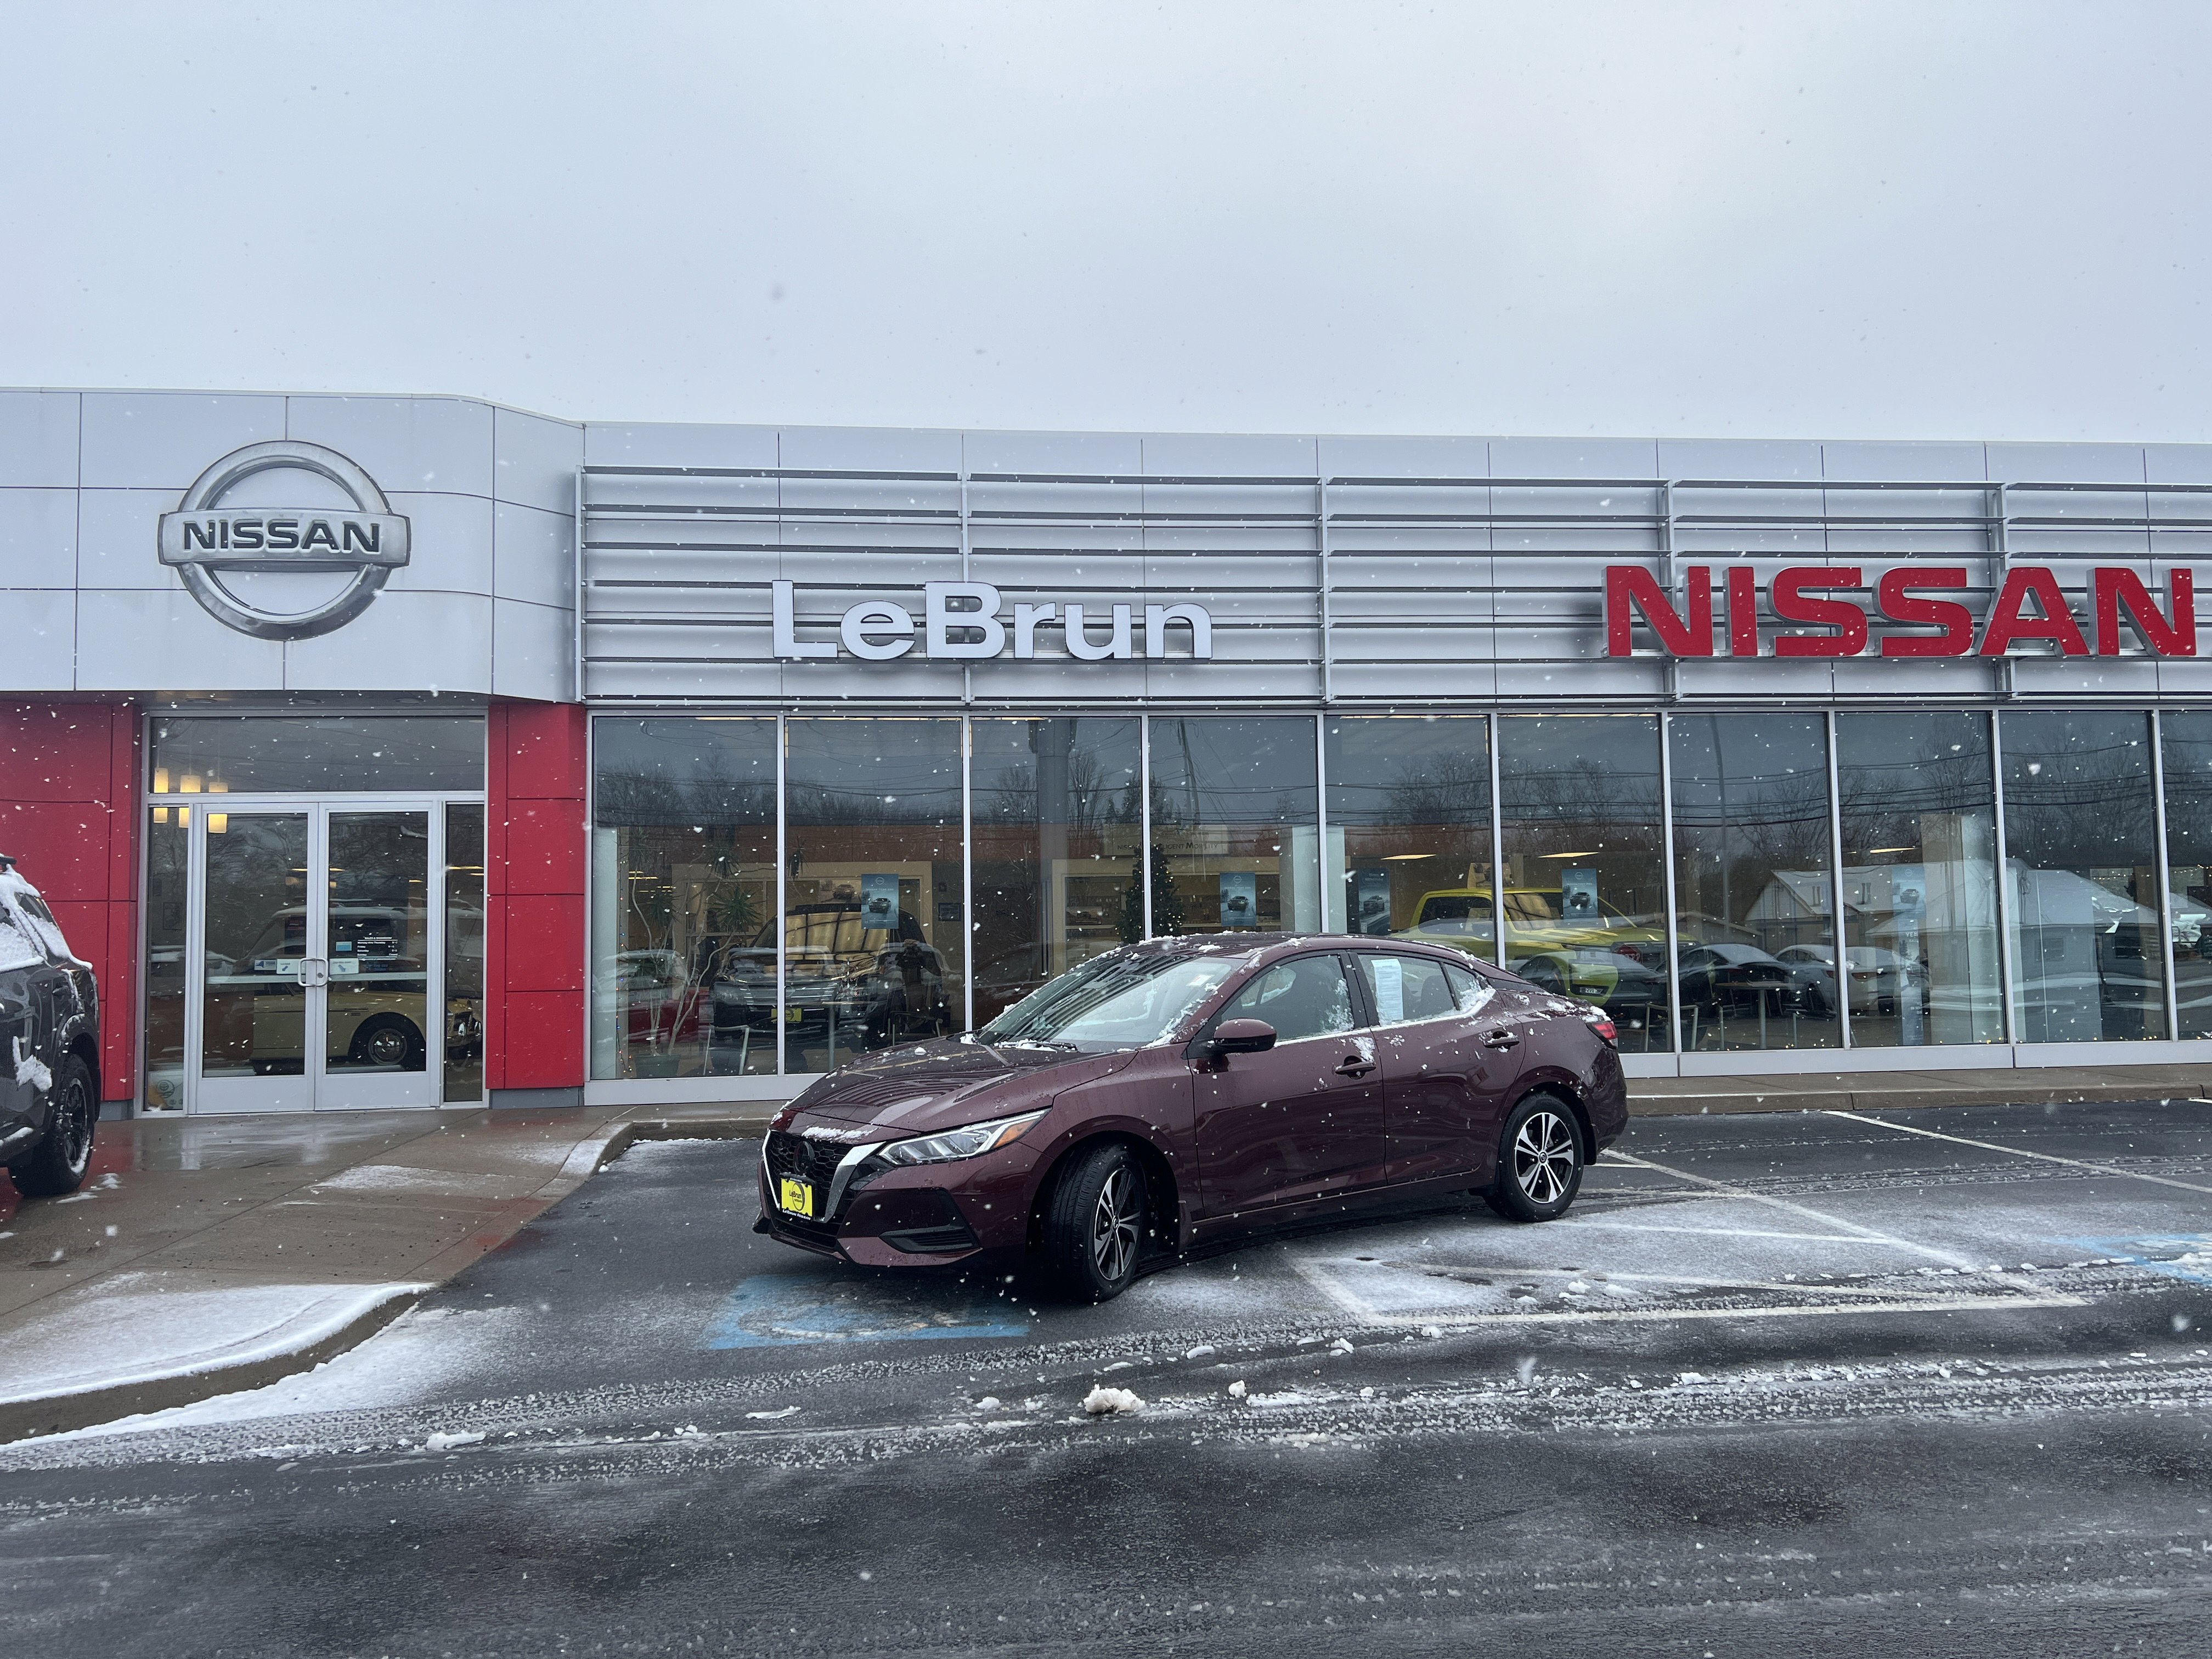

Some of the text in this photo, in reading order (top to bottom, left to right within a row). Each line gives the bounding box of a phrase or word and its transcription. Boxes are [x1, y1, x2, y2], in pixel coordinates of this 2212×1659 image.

[184, 521, 380, 552] NISSAN
[772, 579, 1213, 660] LeBrun
[1602, 565, 2197, 657] NISSAN
[789, 1189, 802, 1199] LeBrun
